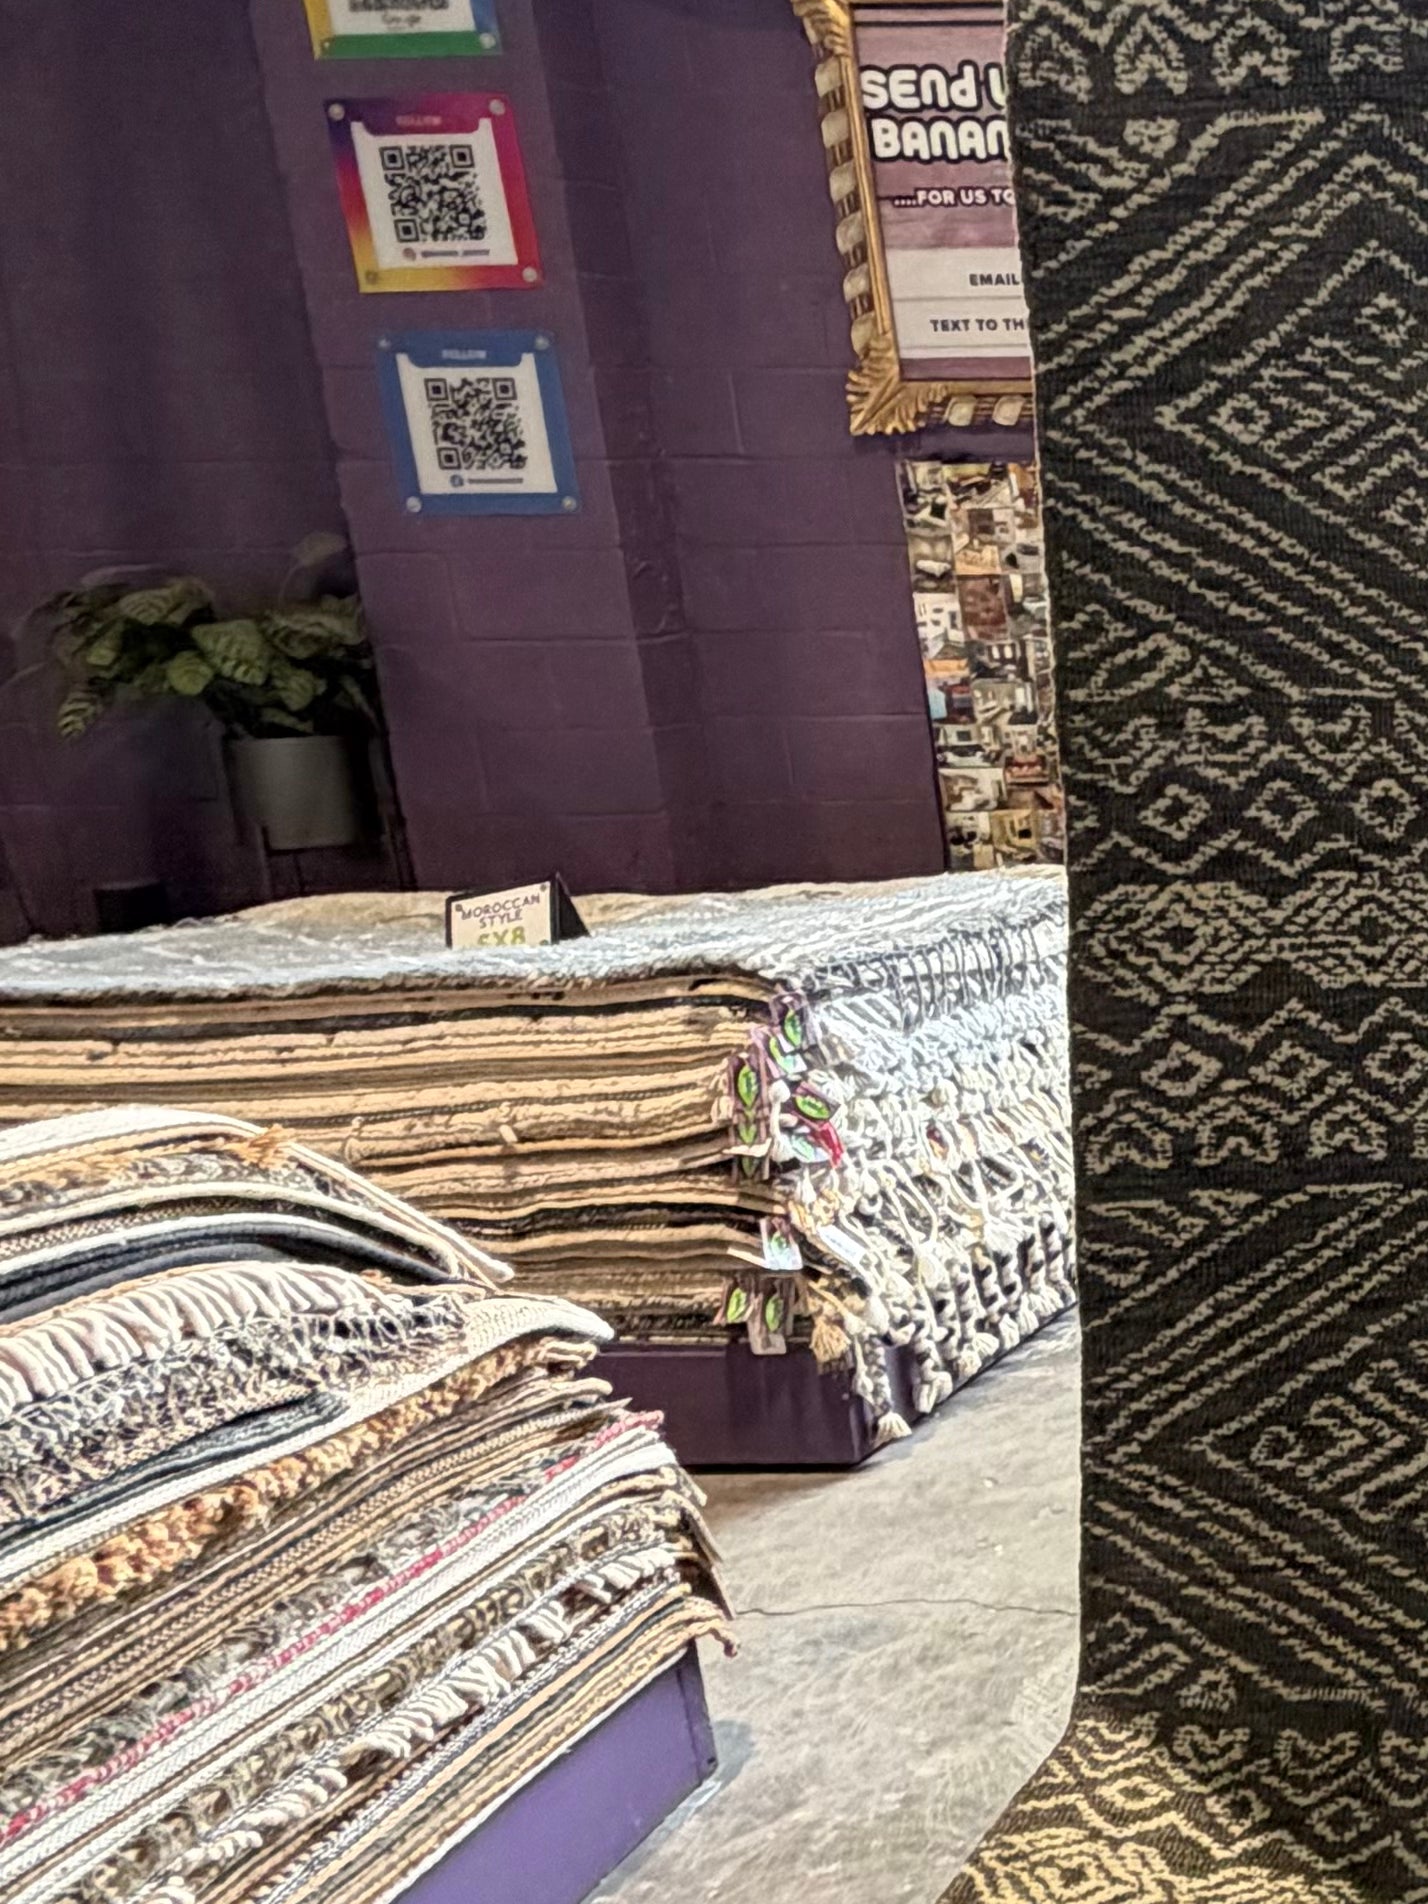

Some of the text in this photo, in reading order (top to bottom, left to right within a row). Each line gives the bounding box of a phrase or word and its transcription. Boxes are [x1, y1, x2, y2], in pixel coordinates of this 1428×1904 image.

[960, 189, 987, 205] US
[991, 188, 1015, 205] TO
[969, 273, 1020, 286] EMAIL
[930, 318, 1025, 332] TEXT TO TH
[461, 894, 540, 920] MOROCCAN
[480, 909, 523, 928] STYLE
